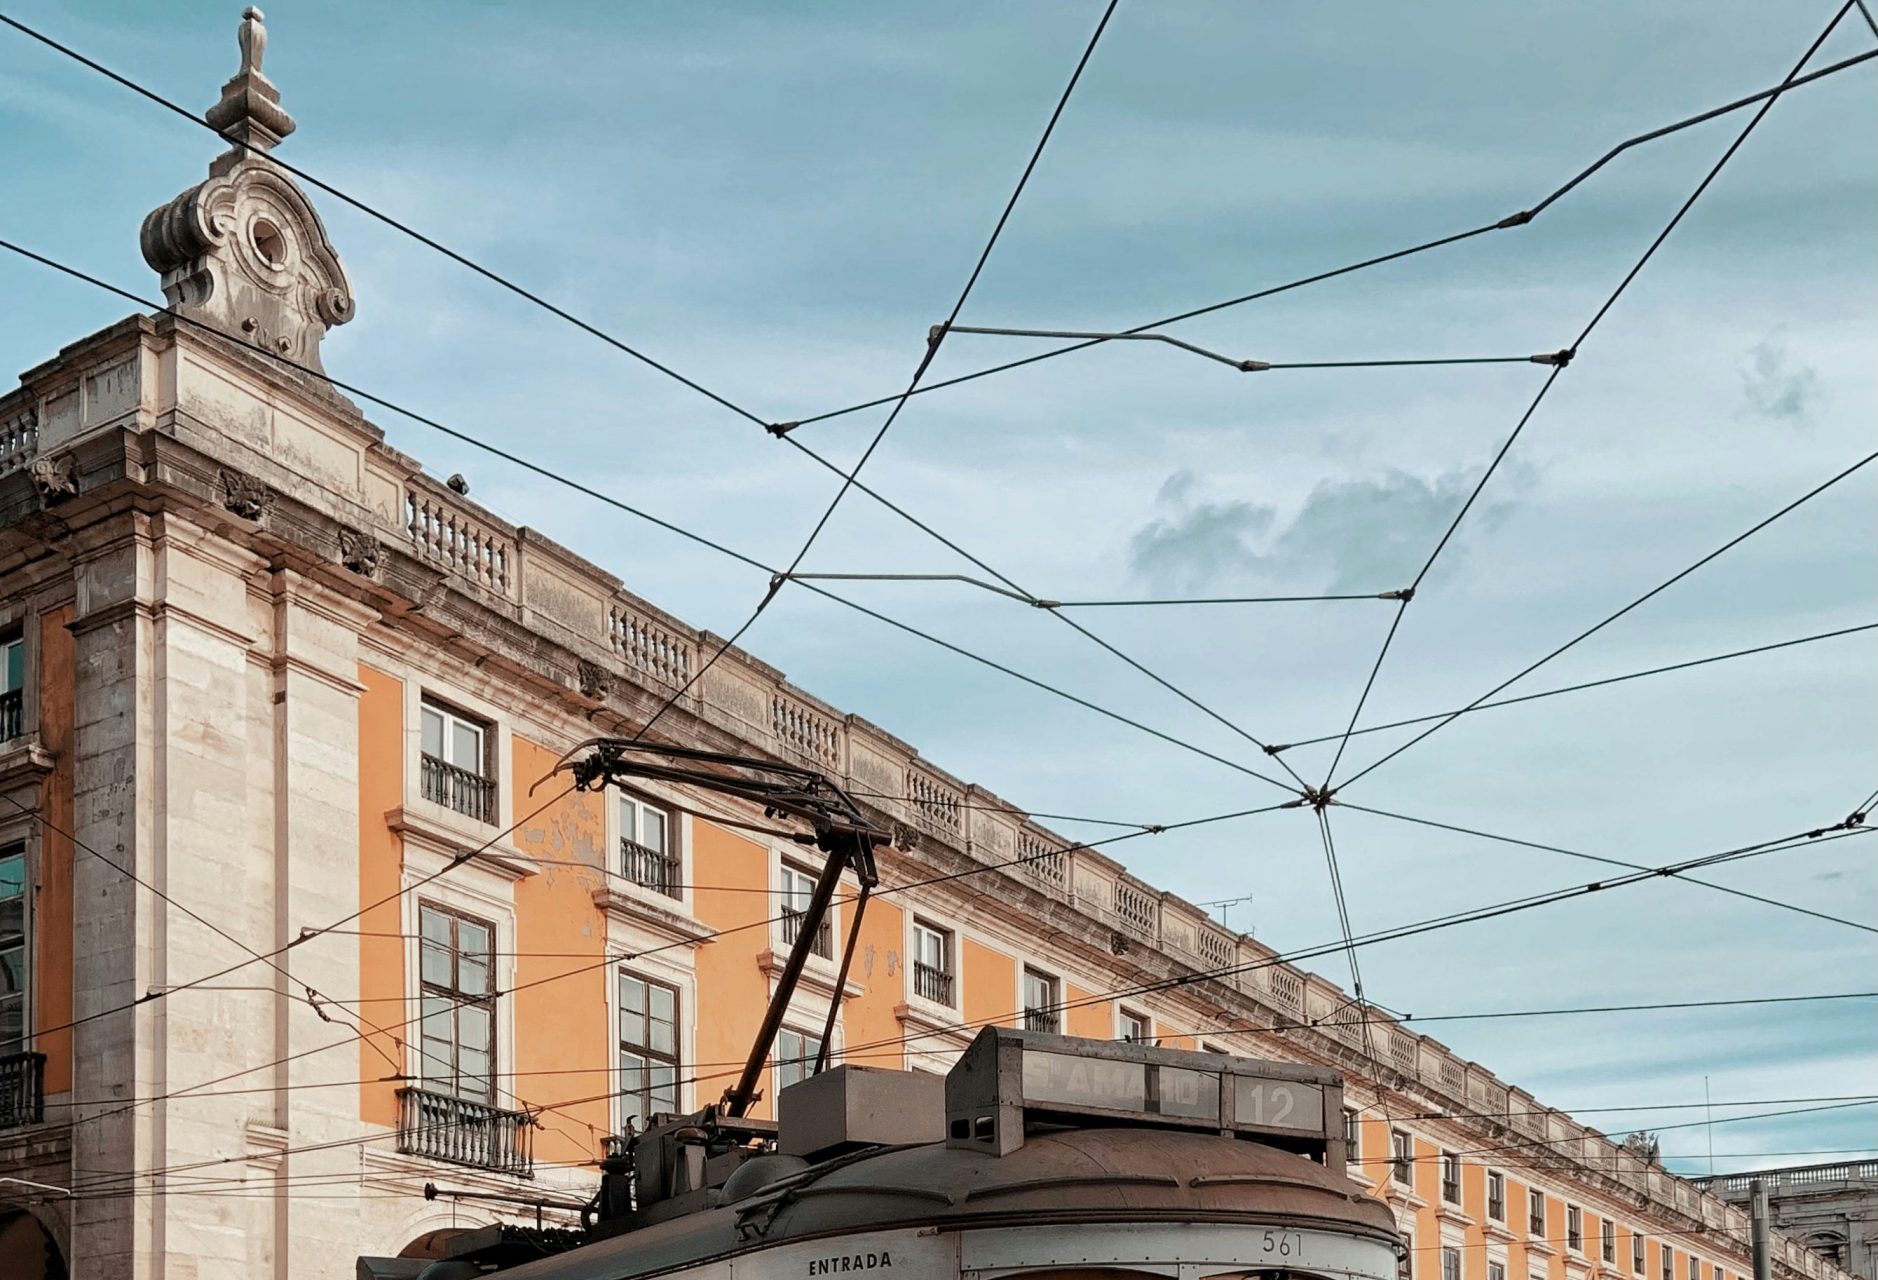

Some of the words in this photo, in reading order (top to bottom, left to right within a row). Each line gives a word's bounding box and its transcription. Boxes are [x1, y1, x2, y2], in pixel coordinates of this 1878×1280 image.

[1251, 1084, 1295, 1128] 12
[1263, 1230, 1301, 1257] 561
[809, 1252, 892, 1276] ENTRADA
